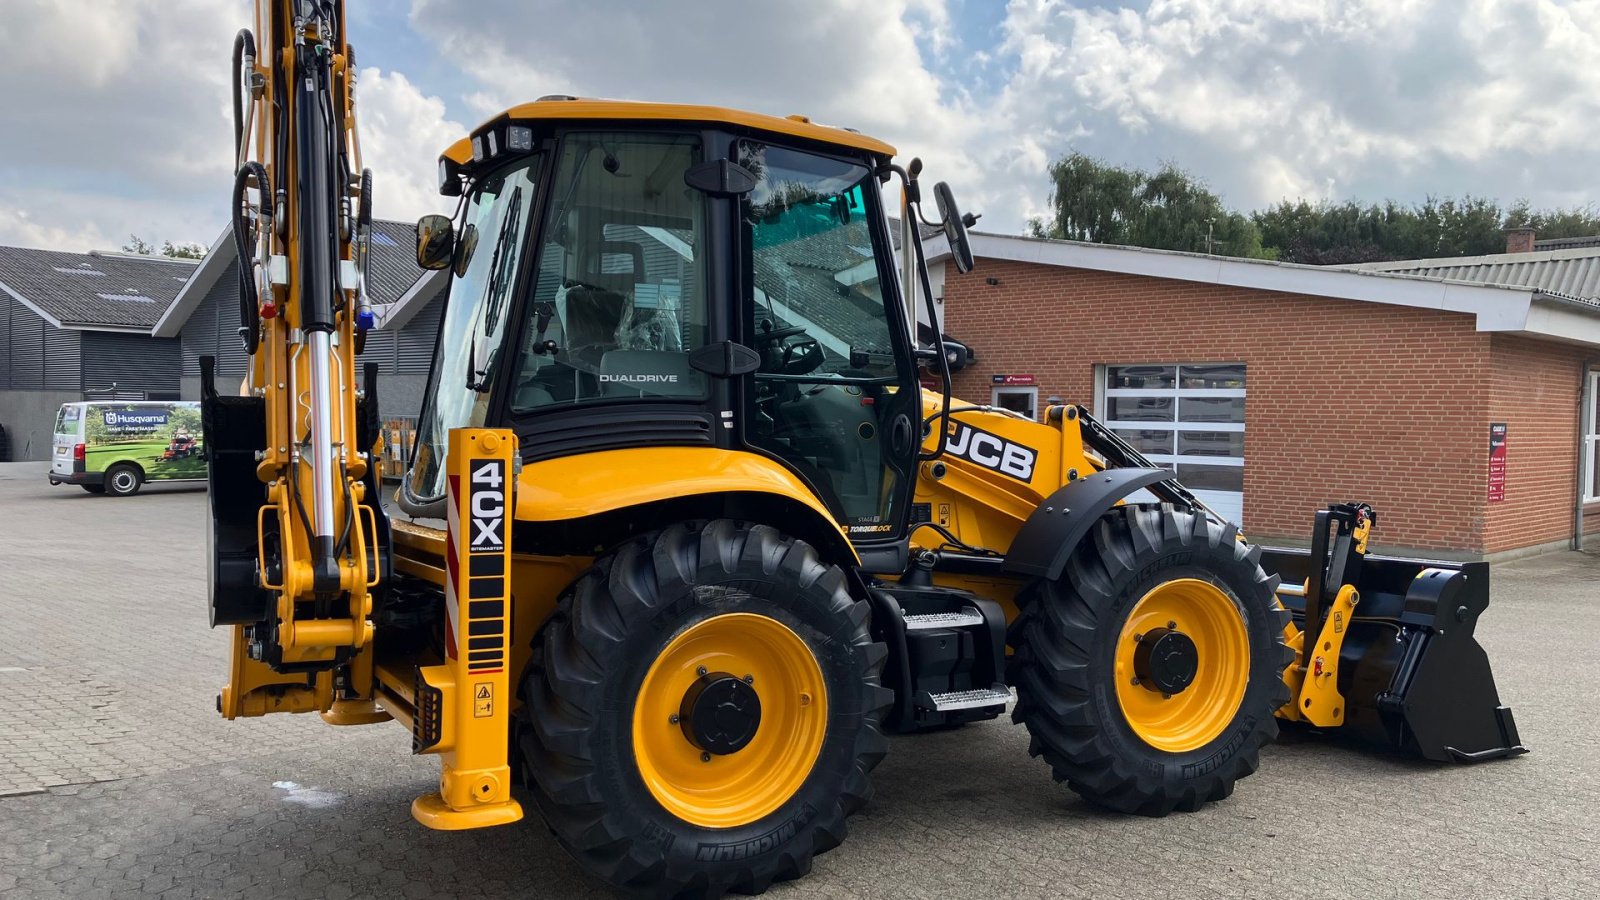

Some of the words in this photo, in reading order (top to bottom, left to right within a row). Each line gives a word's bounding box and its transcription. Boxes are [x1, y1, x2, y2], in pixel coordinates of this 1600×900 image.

[600, 374, 678, 382] DUALDRIVE
[117, 414, 165, 424] Husqvarna
[945, 426, 1034, 479] JCB
[472, 462, 504, 546] 4CX
[1183, 733, 1244, 780] MICHELIN
[697, 823, 796, 861] MICHELIN
